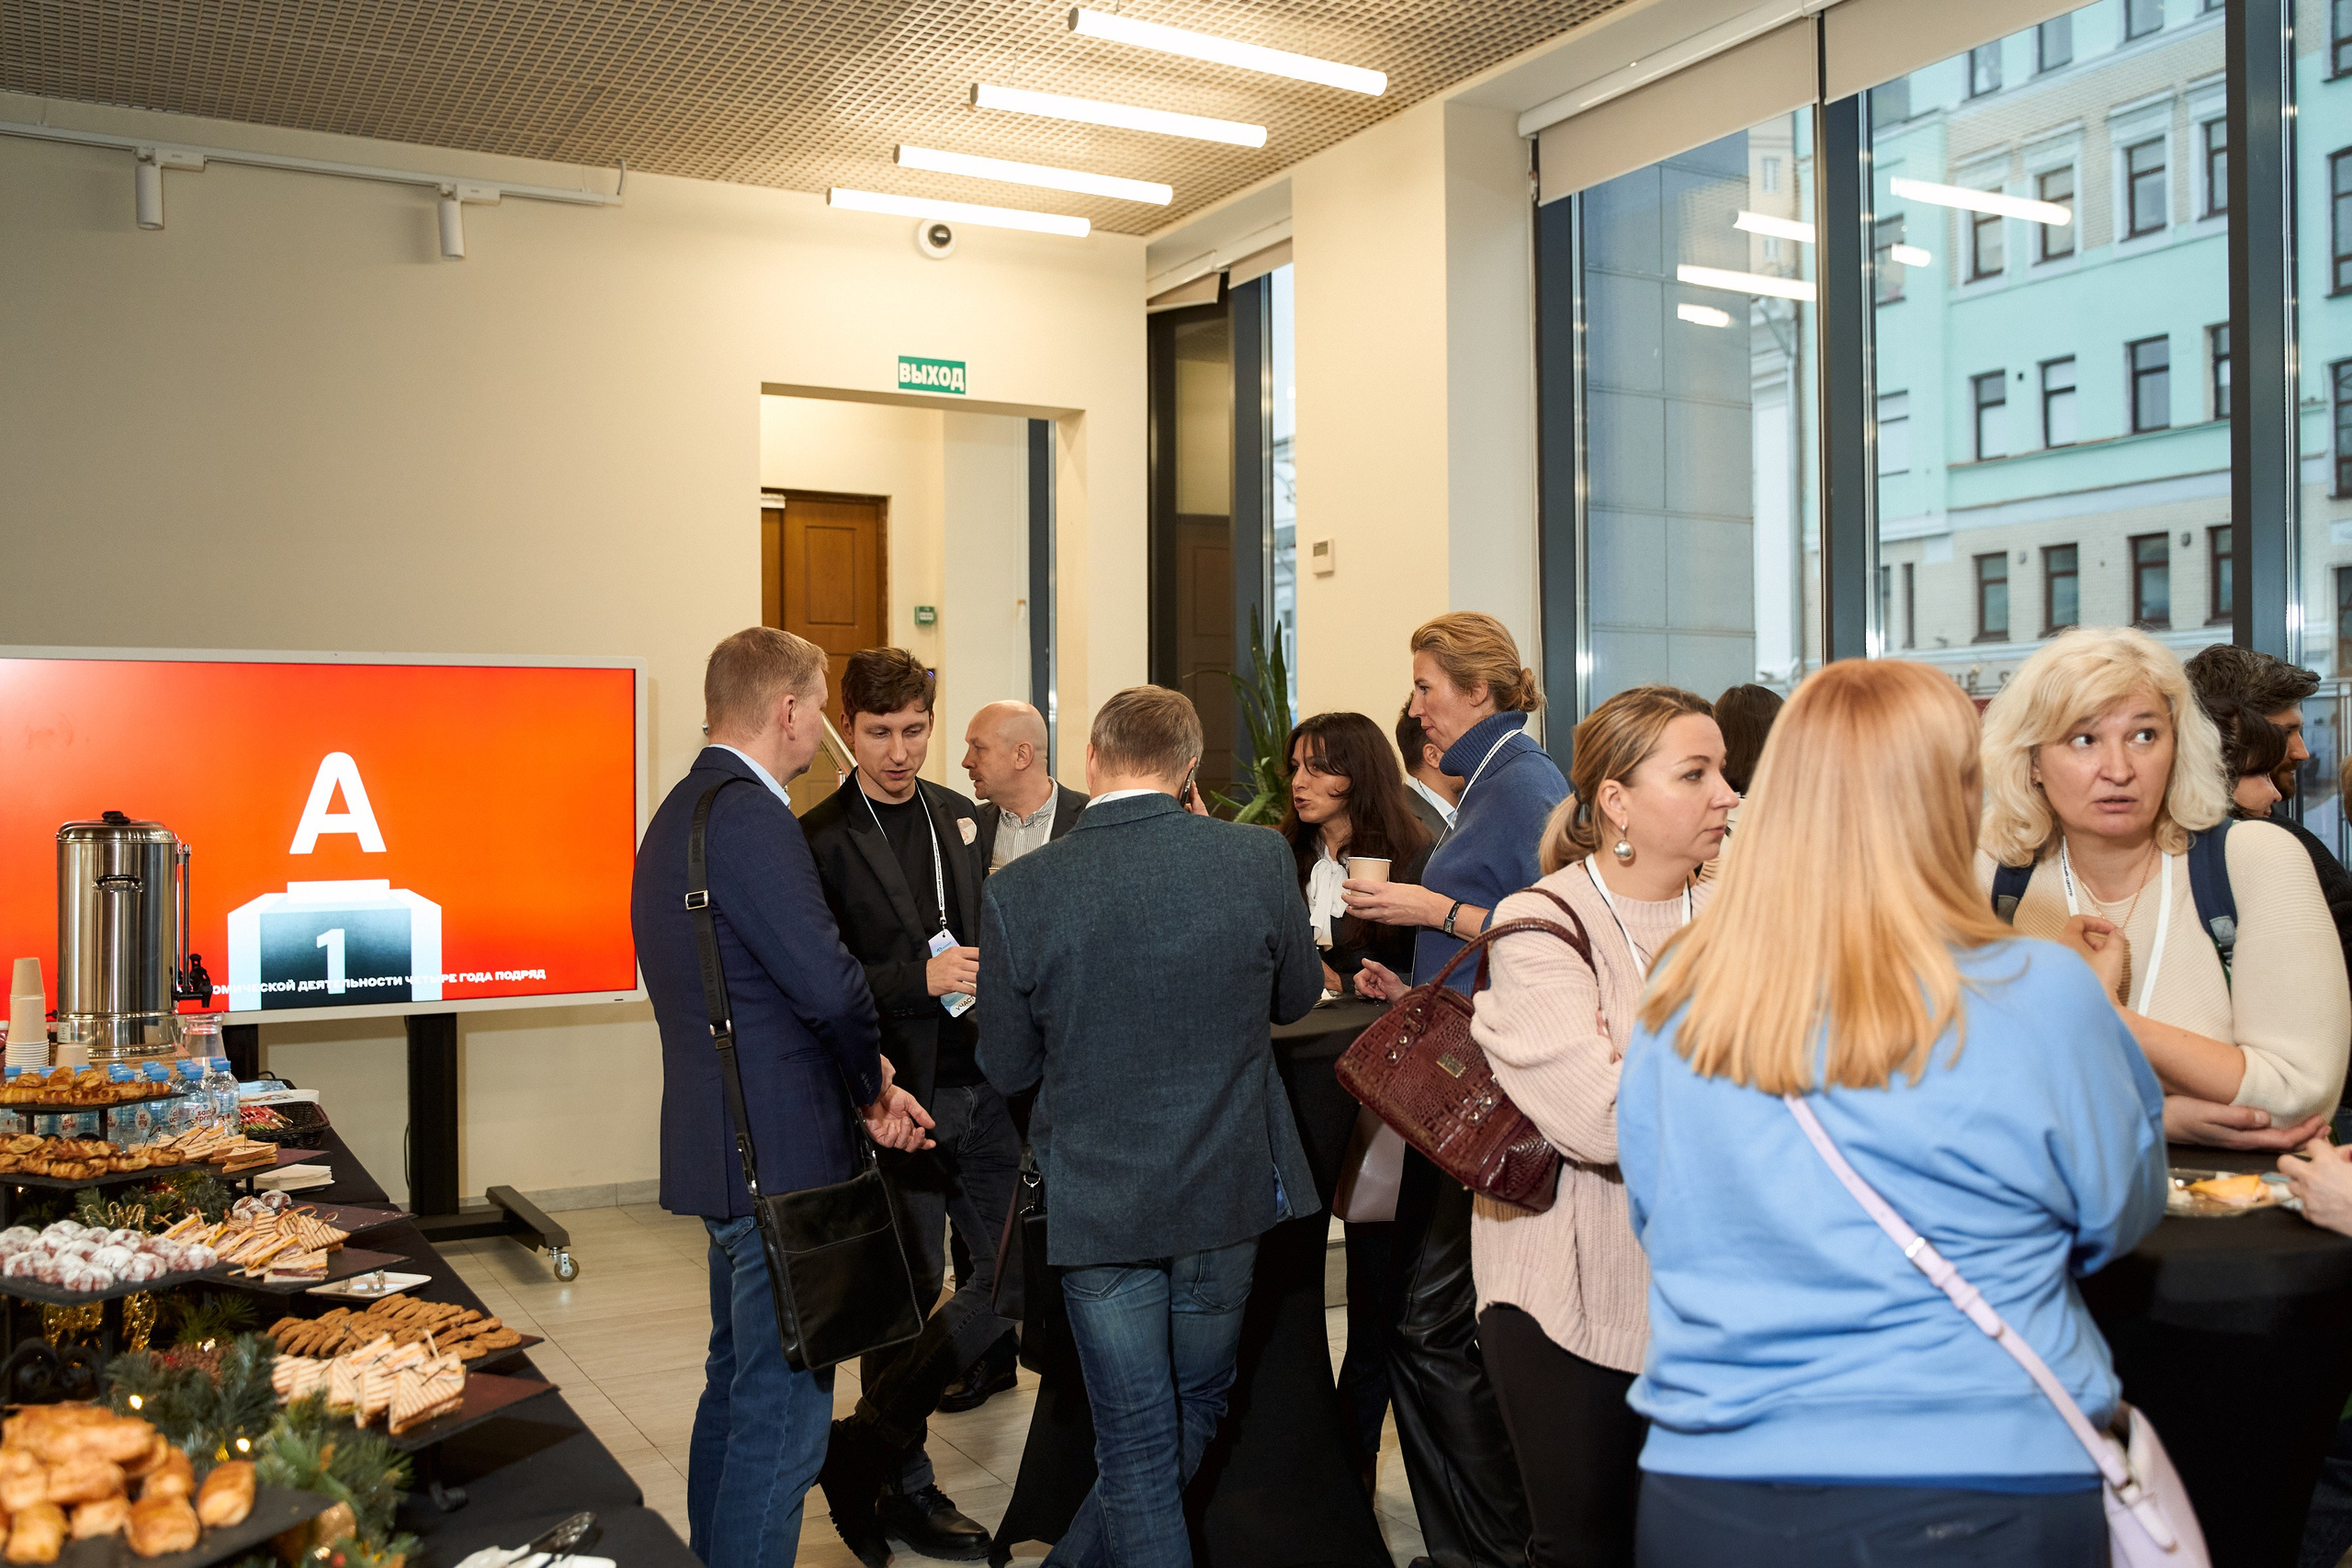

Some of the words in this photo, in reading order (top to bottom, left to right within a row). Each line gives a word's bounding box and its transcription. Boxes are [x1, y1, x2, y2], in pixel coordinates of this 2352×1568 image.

[899, 363, 965, 391] ВЫХОД
[288, 751, 387, 854] А
[212, 979, 296, 995] ОМИЧЕСКОЙ
[298, 976, 402, 992] ДЕЯТЕЛЬНОСТИ
[405, 973, 458, 985] ЧЕТЫРЕ
[459, 971, 493, 983] ГОДА
[495, 969, 547, 981] ПОДРЯД
[316, 929, 345, 994] 1
